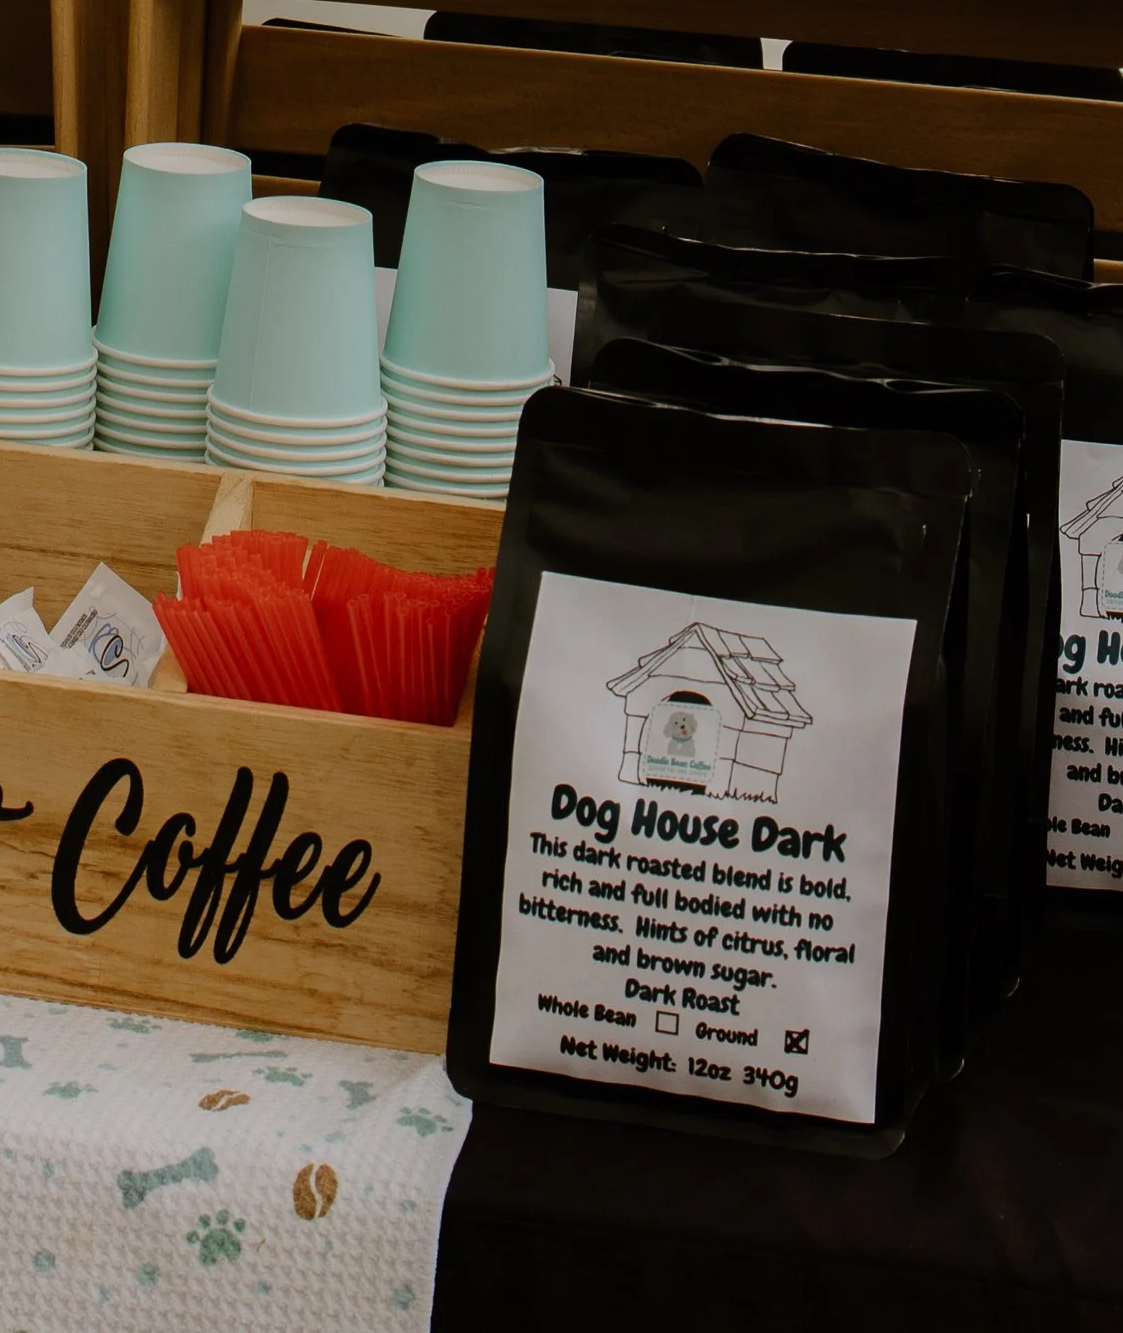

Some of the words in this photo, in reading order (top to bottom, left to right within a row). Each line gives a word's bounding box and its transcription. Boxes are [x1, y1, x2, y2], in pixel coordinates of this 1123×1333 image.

[1059, 705, 1094, 725] and
[1066, 763, 1102, 783] and
[551, 784, 620, 844] Dog
[631, 796, 740, 849] House
[751, 816, 847, 863] Dark
[1071, 818, 1111, 838] Bean
[51, 758, 381, 965] Coffee
[530, 832, 568, 858] This
[573, 840, 621, 869] dark
[626, 855, 706, 883] roasted
[712, 863, 772, 891] blend
[778, 872, 793, 894] is
[799, 874, 851, 902] bold,
[519, 893, 623, 934] bitterness.
[635, 916, 688, 944] Hints
[693, 926, 719, 948] of
[722, 931, 788, 960] citrus,
[794, 939, 855, 964] floral
[542, 869, 582, 894] rich
[588, 880, 626, 902] and
[631, 883, 668, 909] full
[675, 890, 746, 920] bodied
[752, 904, 802, 928] with
[808, 913, 834, 931] no
[592, 945, 631, 966] and
[637, 948, 706, 979] brown
[710, 964, 777, 992] sugar.
[625, 978, 676, 1006] Dark
[682, 987, 740, 1016] Roast
[538, 994, 589, 1019] Whole
[594, 1004, 637, 1028] Bean
[695, 1022, 758, 1047] Ground
[560, 1035, 597, 1060] Net
[688, 1057, 732, 1081] 12oz
[743, 1066, 798, 1098] 340g
